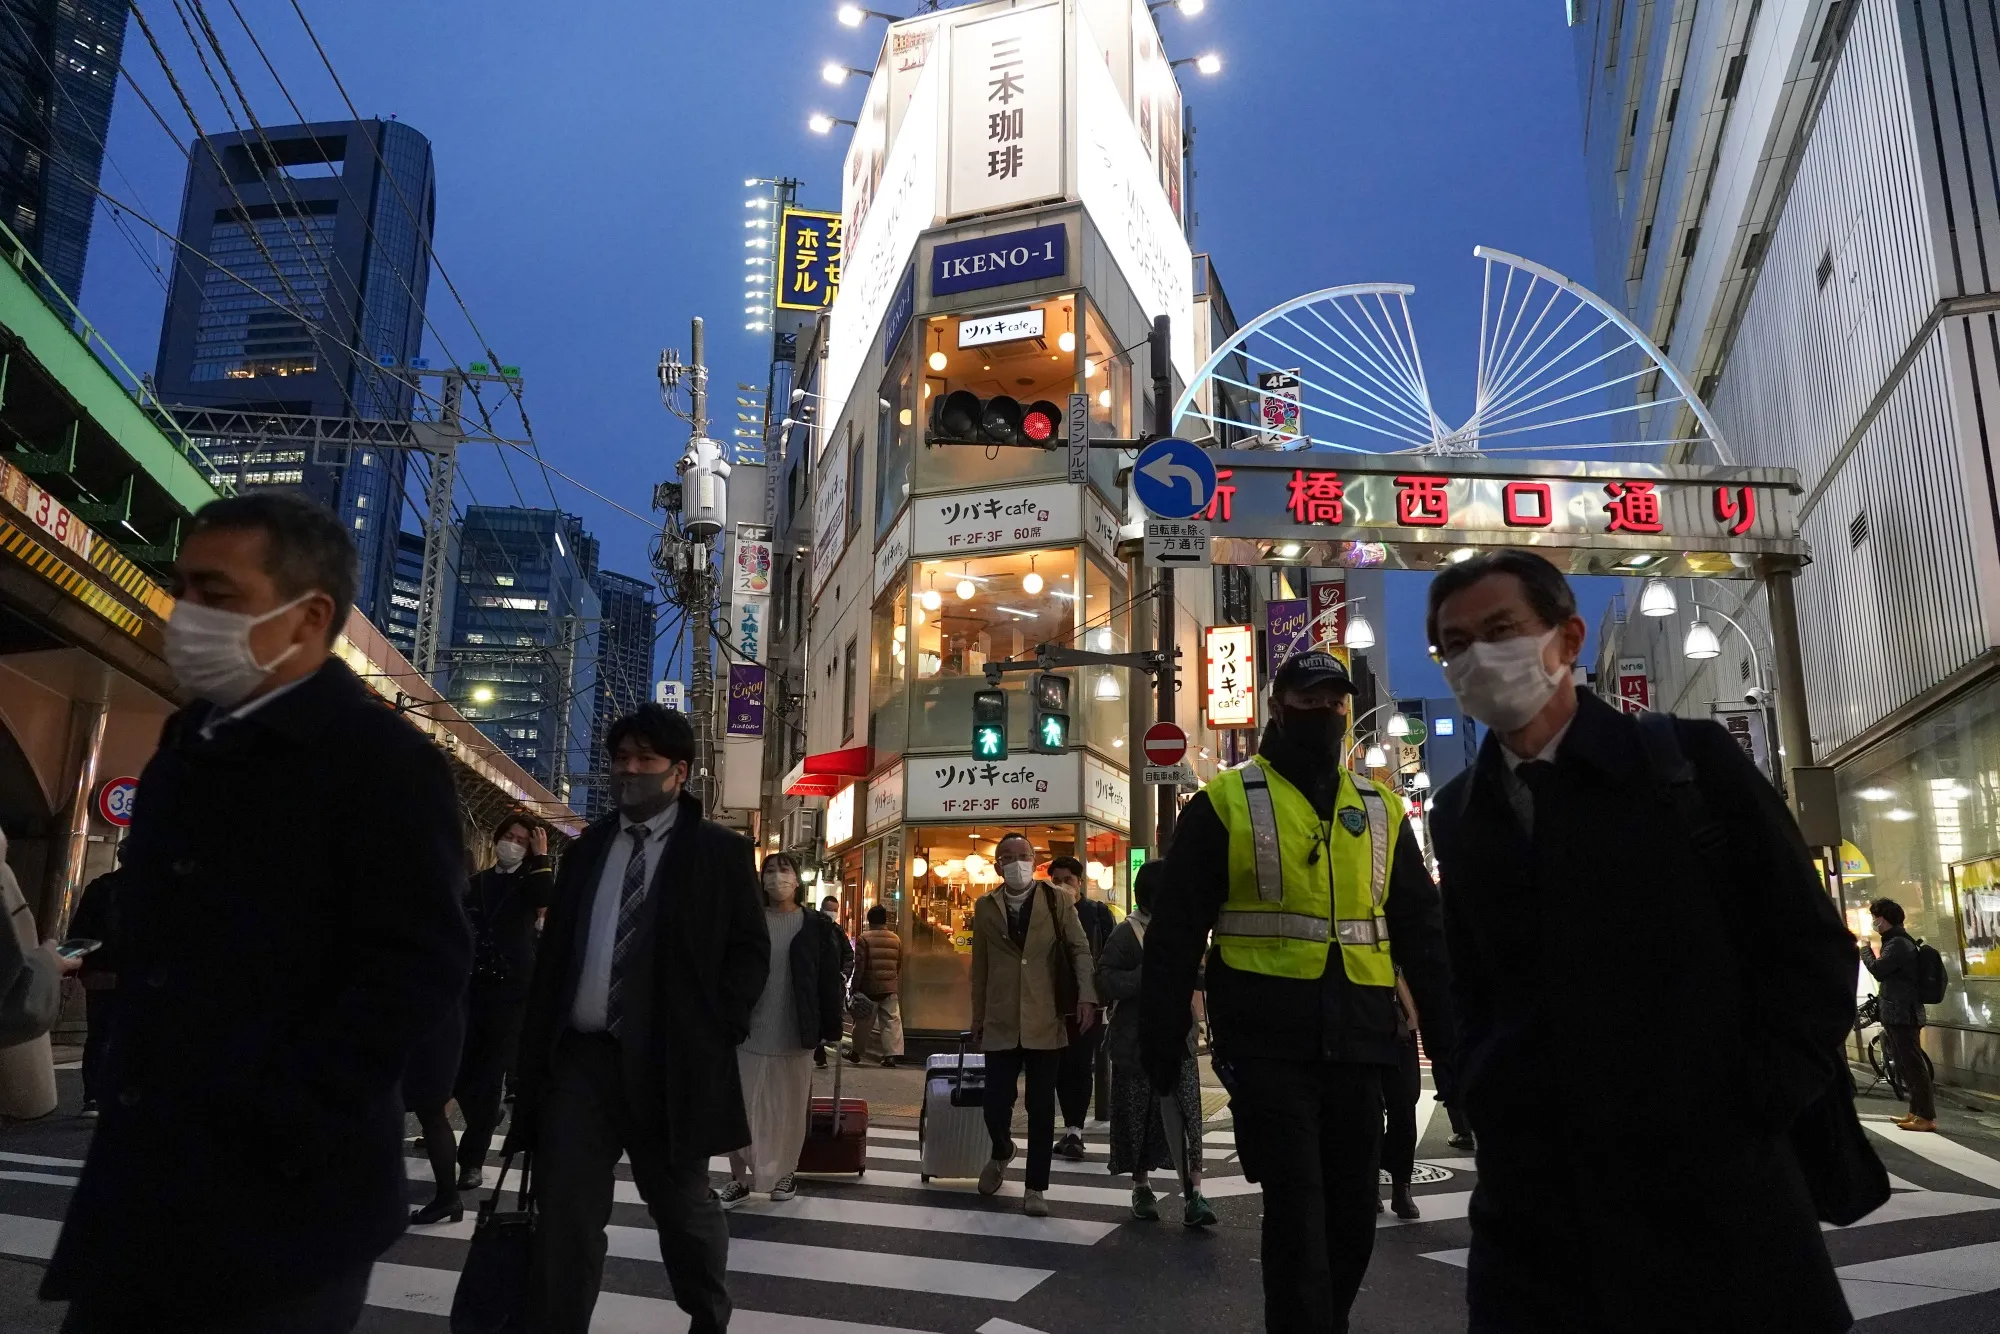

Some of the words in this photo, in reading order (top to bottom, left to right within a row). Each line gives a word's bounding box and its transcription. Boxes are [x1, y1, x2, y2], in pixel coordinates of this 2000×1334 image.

[987, 36, 1025, 181] 三本珈琲
[793, 228, 820, 293] ホテル
[941, 240, 1056, 280] IKENO-1
[1266, 375, 1291, 388] 4F
[1071, 396, 1086, 481] スクランブル式
[743, 527, 767, 540] 4F
[1014, 526, 1042, 540] 60席
[1149, 524, 1205, 536] 自転車を除く
[1149, 537, 1206, 550] 一方通行
[1270, 612, 1305, 636] Enjoy
[1219, 642, 1237, 695] ツバキ
[732, 680, 763, 700] Enjoy
[1218, 697, 1241, 708] cafe
[1145, 771, 1186, 782] 自転車を除く
[1011, 797, 1040, 810] 60席
